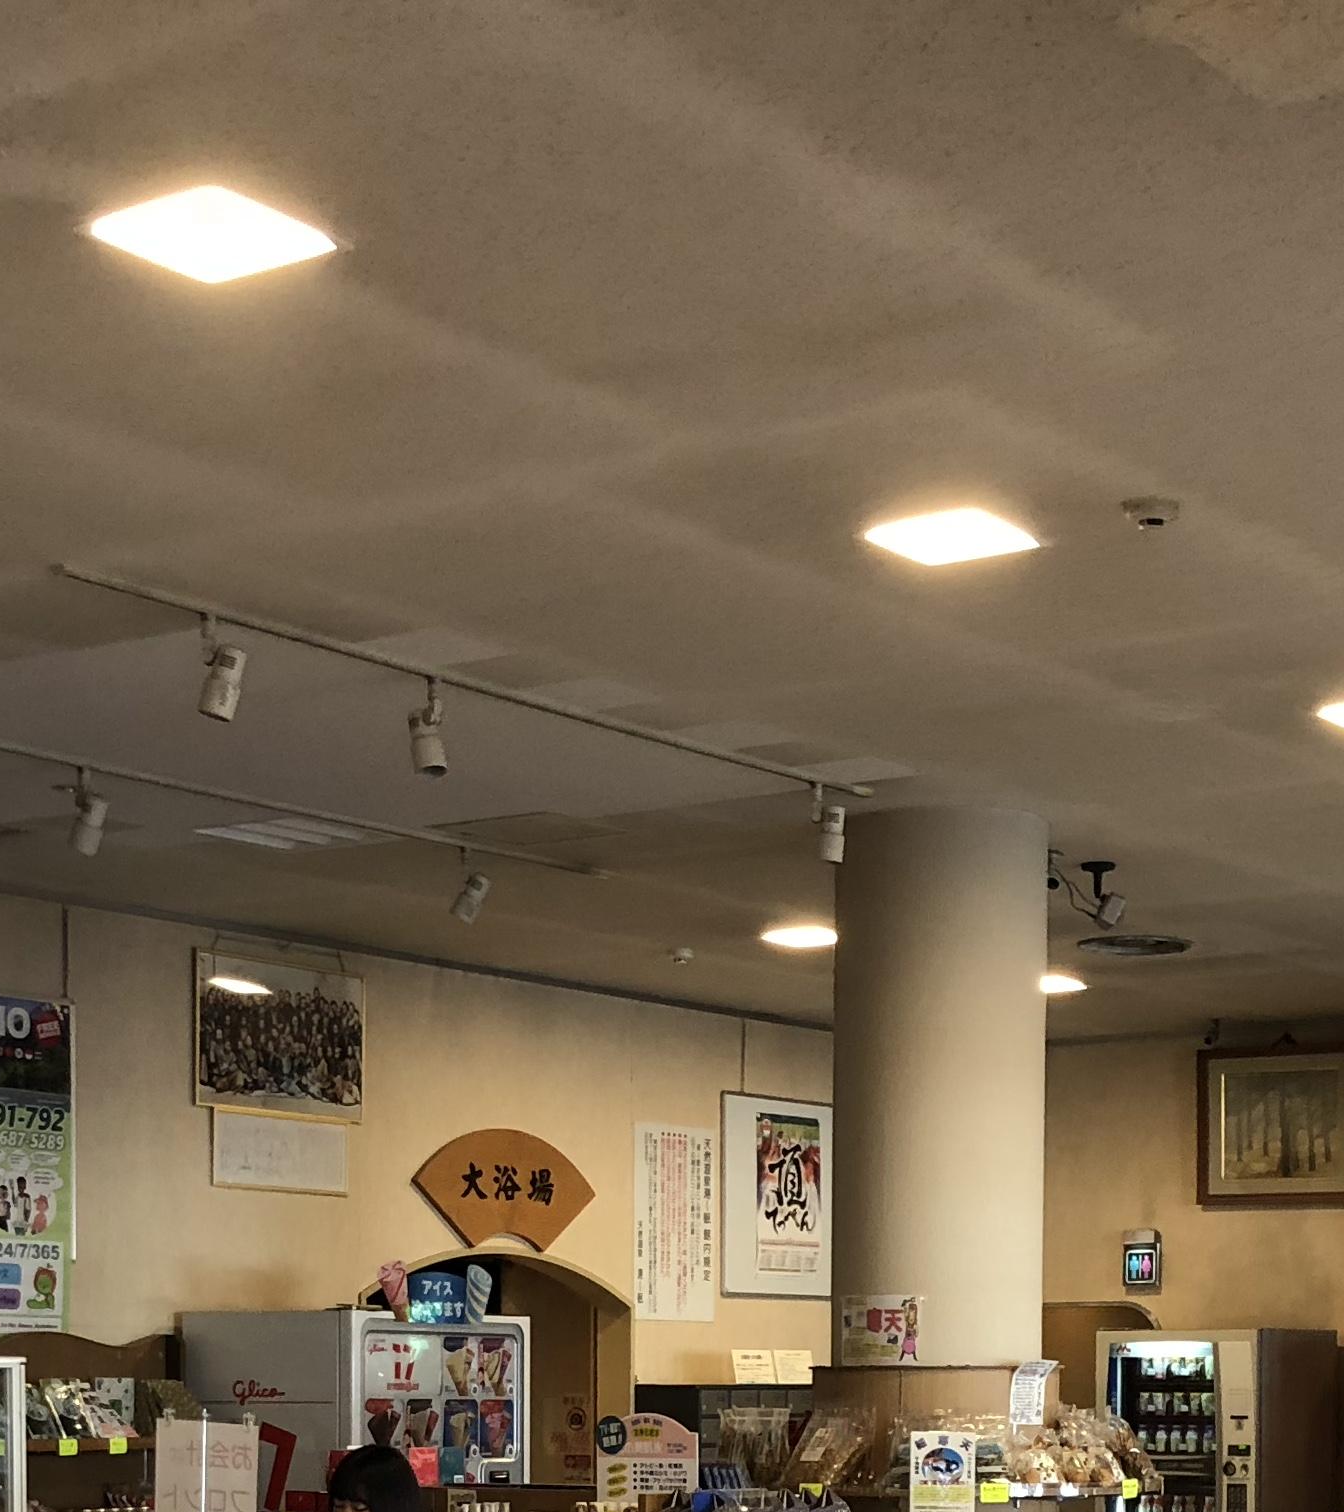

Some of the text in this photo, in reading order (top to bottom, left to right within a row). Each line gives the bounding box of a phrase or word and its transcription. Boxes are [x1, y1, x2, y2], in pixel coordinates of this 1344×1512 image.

[461, 1160, 556, 1207] 大浴場
[421, 1279, 453, 1296] アイス
